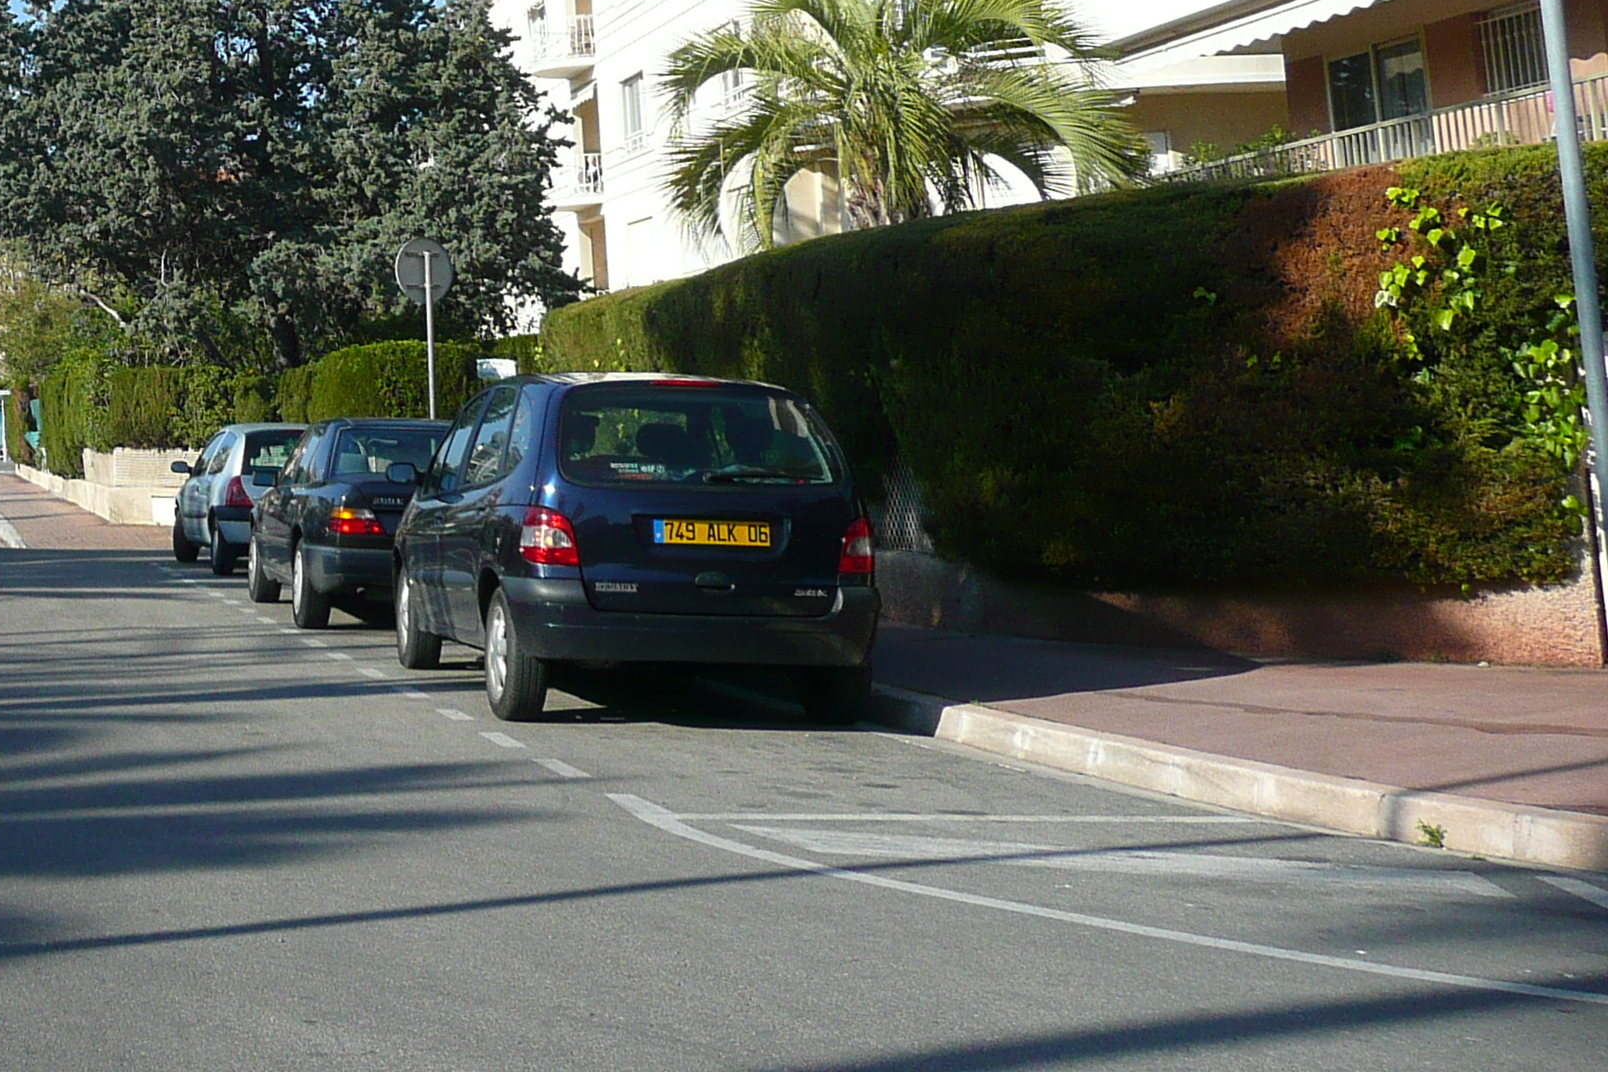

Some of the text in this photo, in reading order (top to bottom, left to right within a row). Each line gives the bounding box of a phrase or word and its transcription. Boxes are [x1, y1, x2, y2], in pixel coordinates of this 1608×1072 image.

[664, 522, 696, 541] 749
[707, 523, 738, 542] ALK
[748, 524, 769, 543] 06
